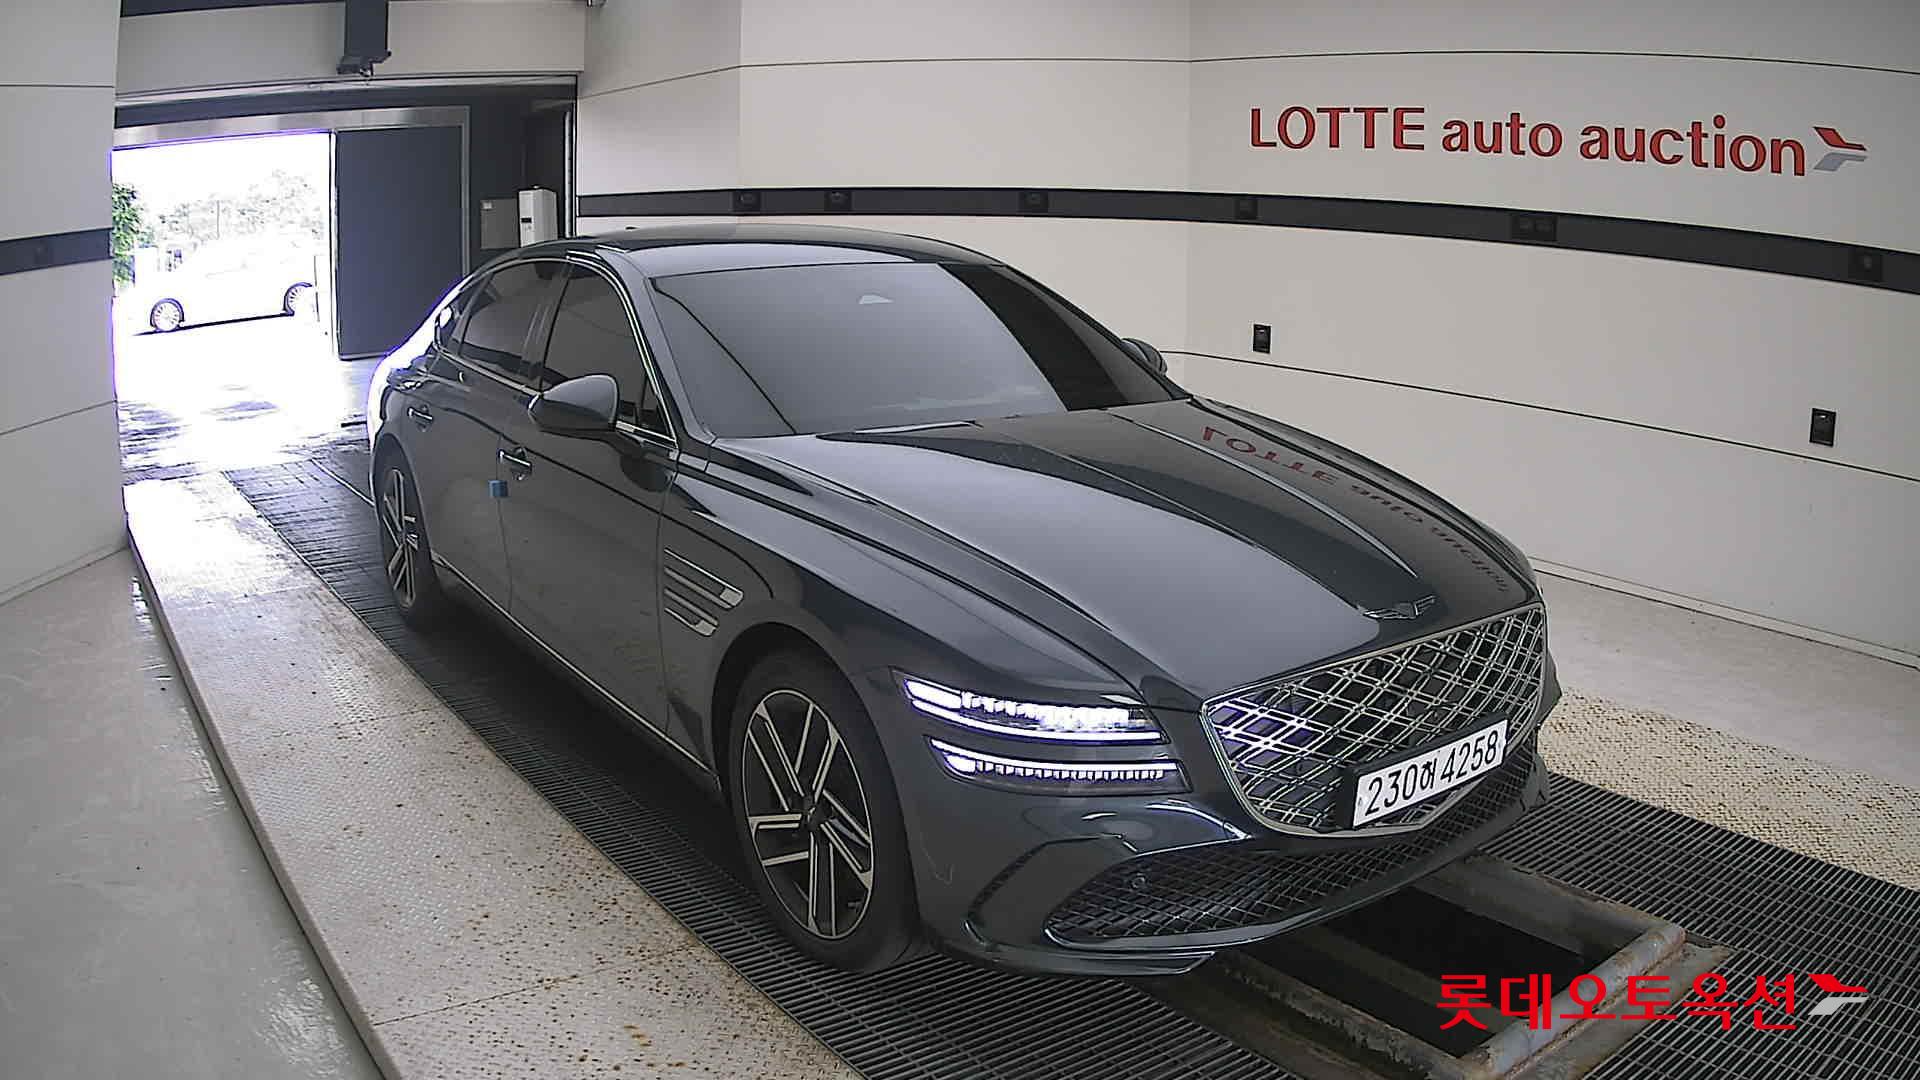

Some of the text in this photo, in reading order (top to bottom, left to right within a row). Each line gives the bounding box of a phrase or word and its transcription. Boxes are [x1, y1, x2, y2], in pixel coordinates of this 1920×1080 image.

[1251, 106, 1806, 177] LOTTE auto auction
[1365, 731, 1498, 816] 230허 4258
